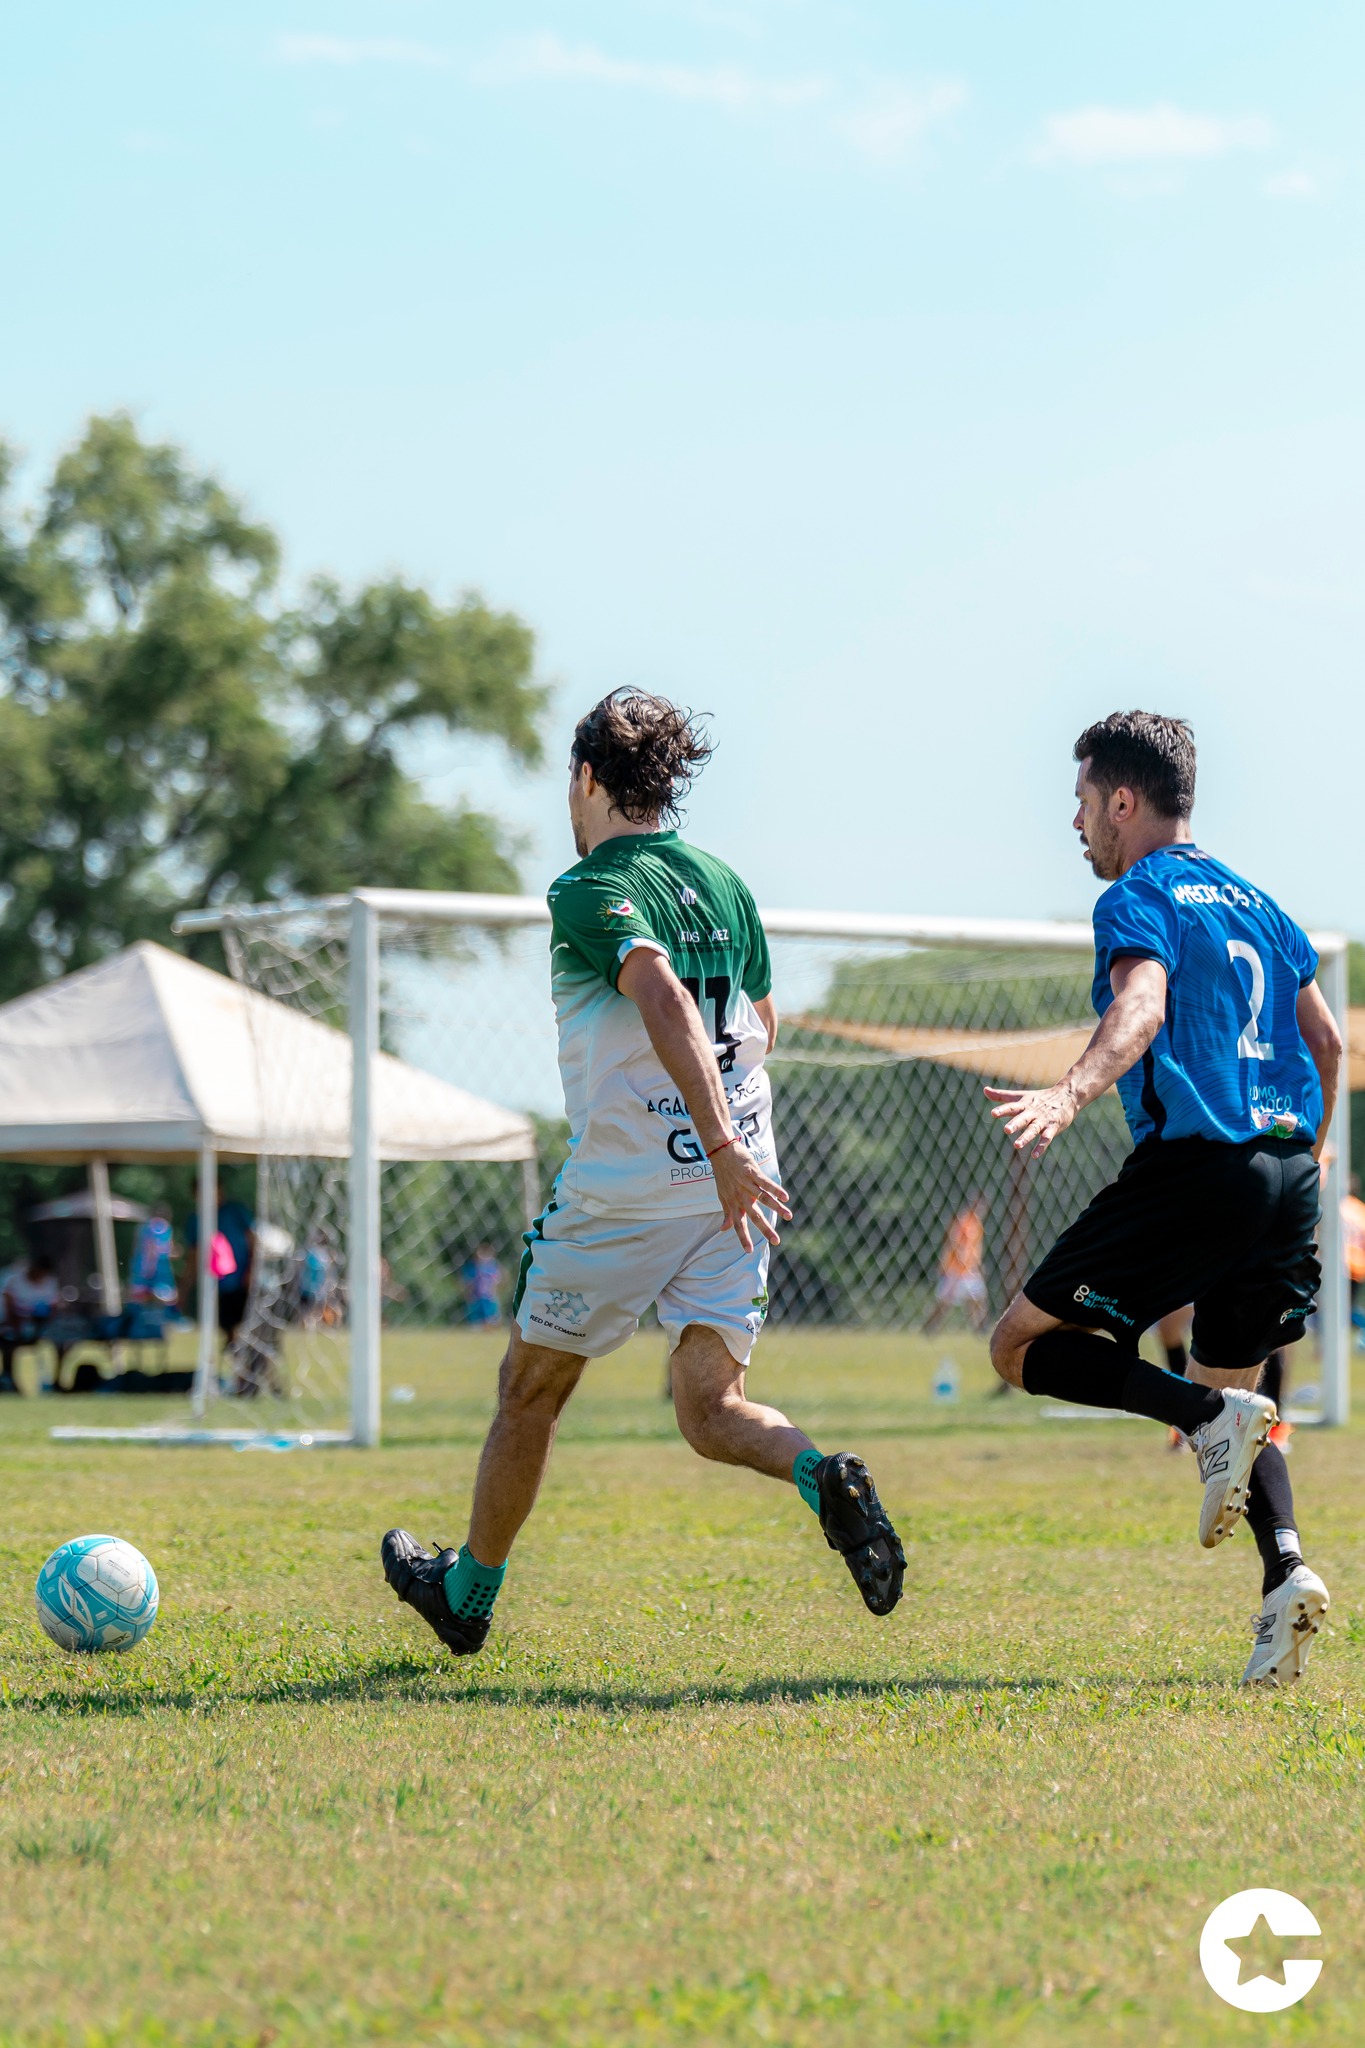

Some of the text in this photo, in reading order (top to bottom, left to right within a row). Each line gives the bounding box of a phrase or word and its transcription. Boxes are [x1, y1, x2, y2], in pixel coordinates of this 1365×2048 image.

[676, 887, 697, 905] VIP
[1226, 940, 1275, 1060] 2
[530, 1314, 587, 1338] RED DE COMPRAS
